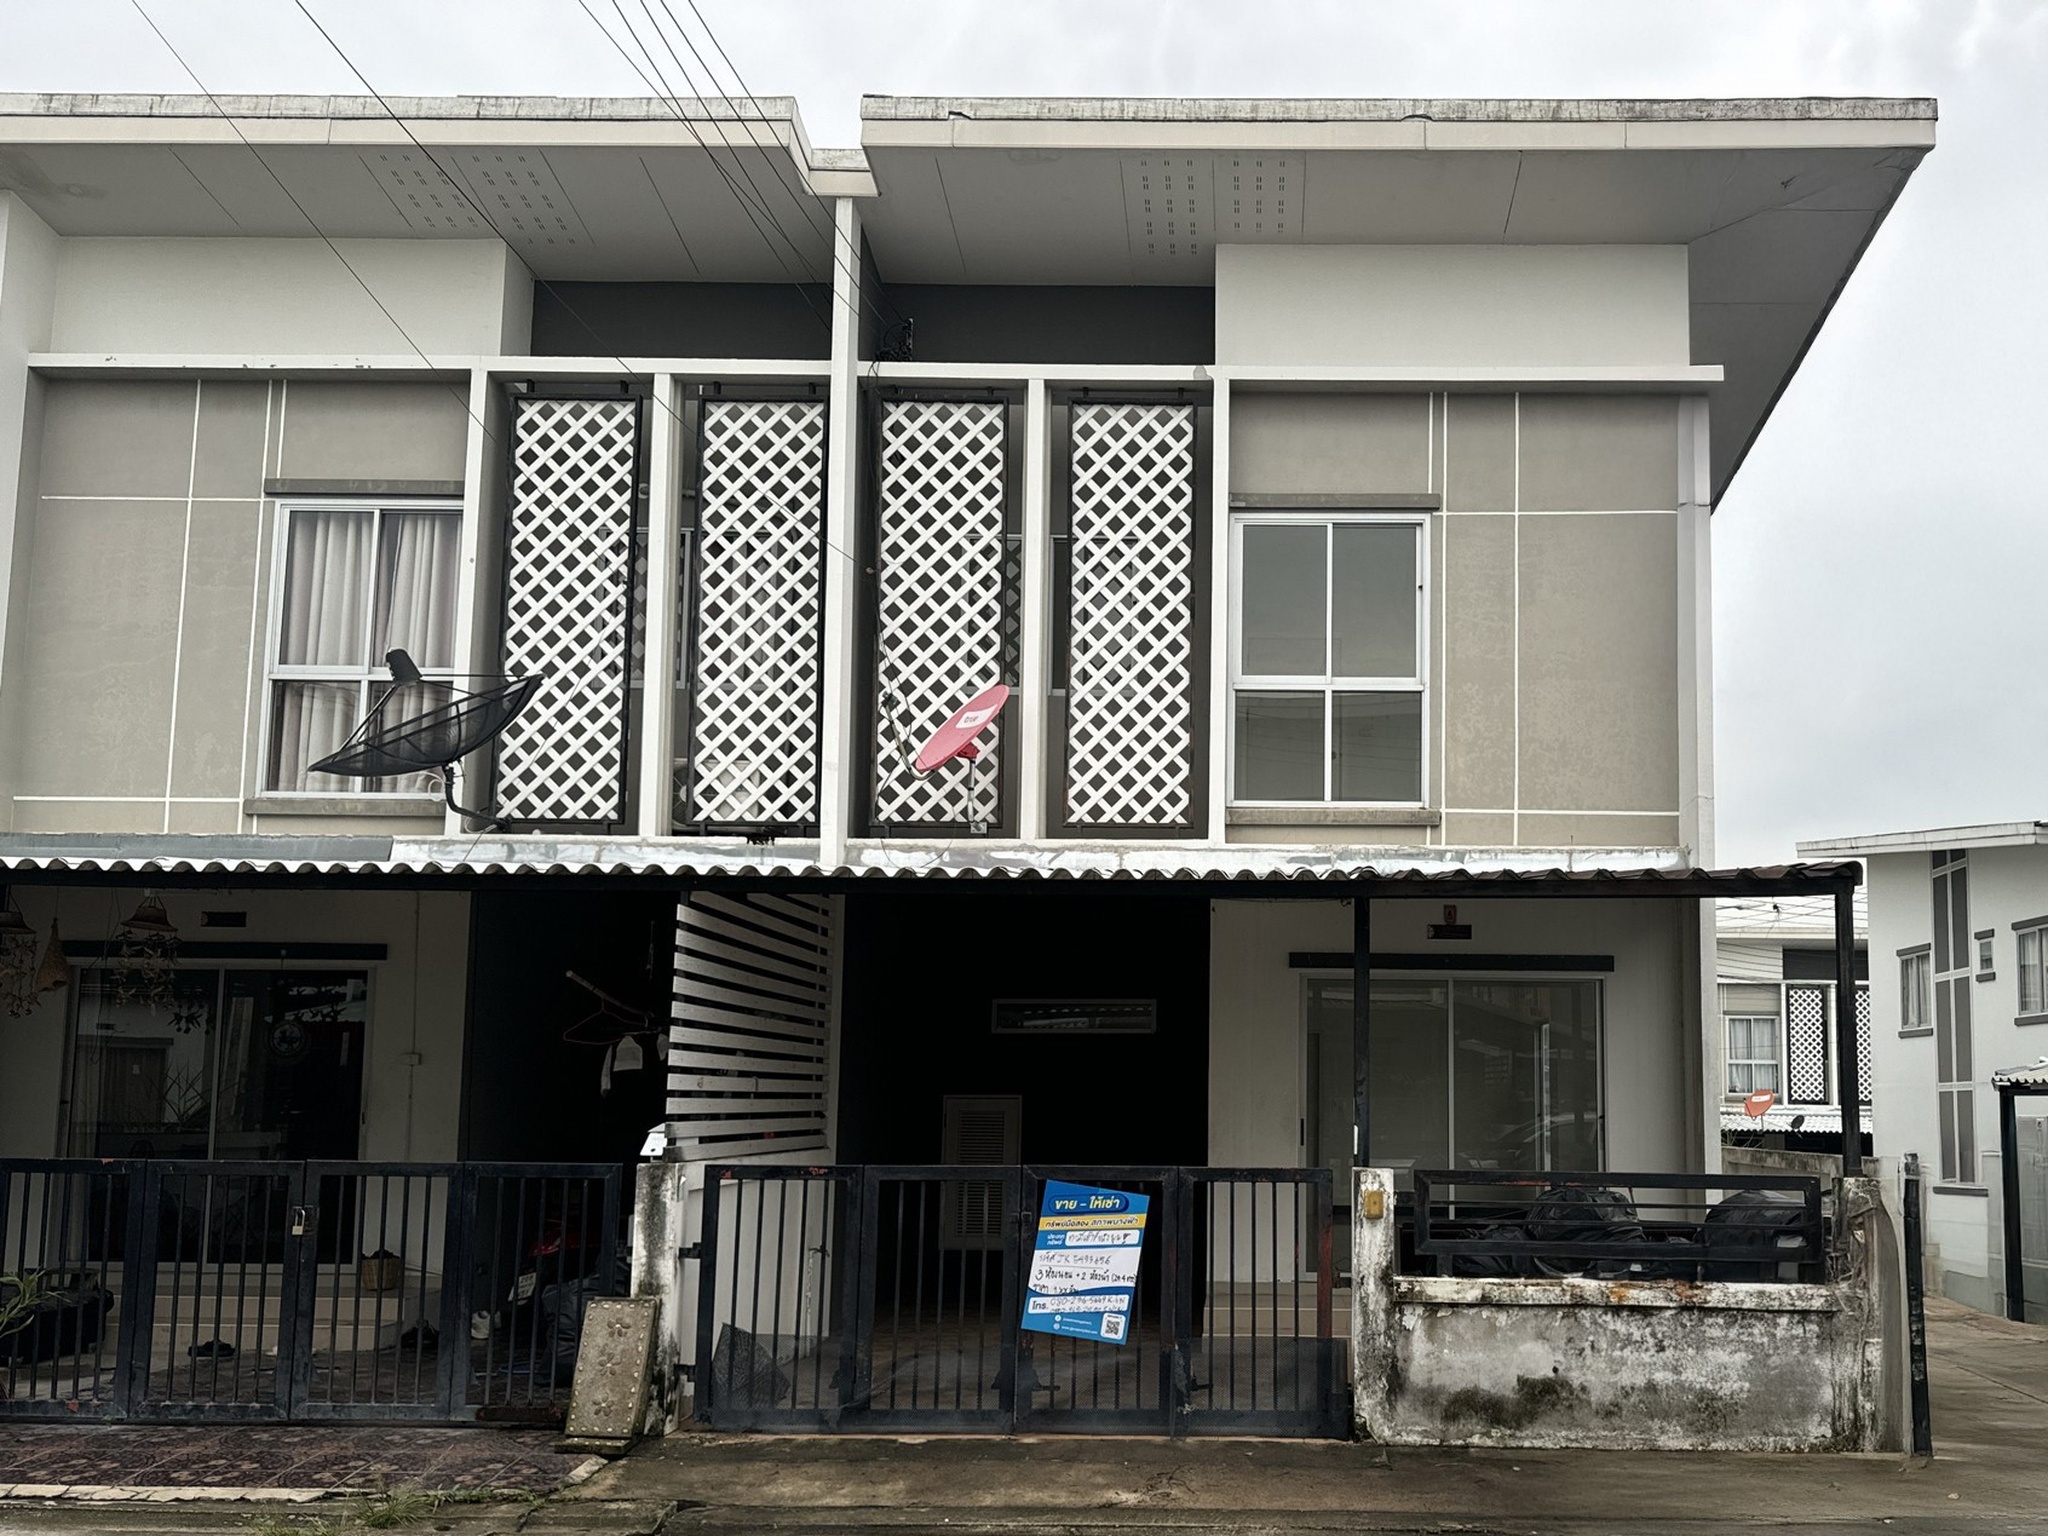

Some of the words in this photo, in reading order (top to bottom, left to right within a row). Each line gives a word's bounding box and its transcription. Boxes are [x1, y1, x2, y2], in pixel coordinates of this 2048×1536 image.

[1055, 1200, 1077, 1209] ขาย
[1089, 1196, 1120, 1209] ให้เช่า
[1035, 1269, 1043, 1281] 3
[1081, 1272, 1086, 1280] 2
[1032, 1301, 1049, 1310] โทร.
